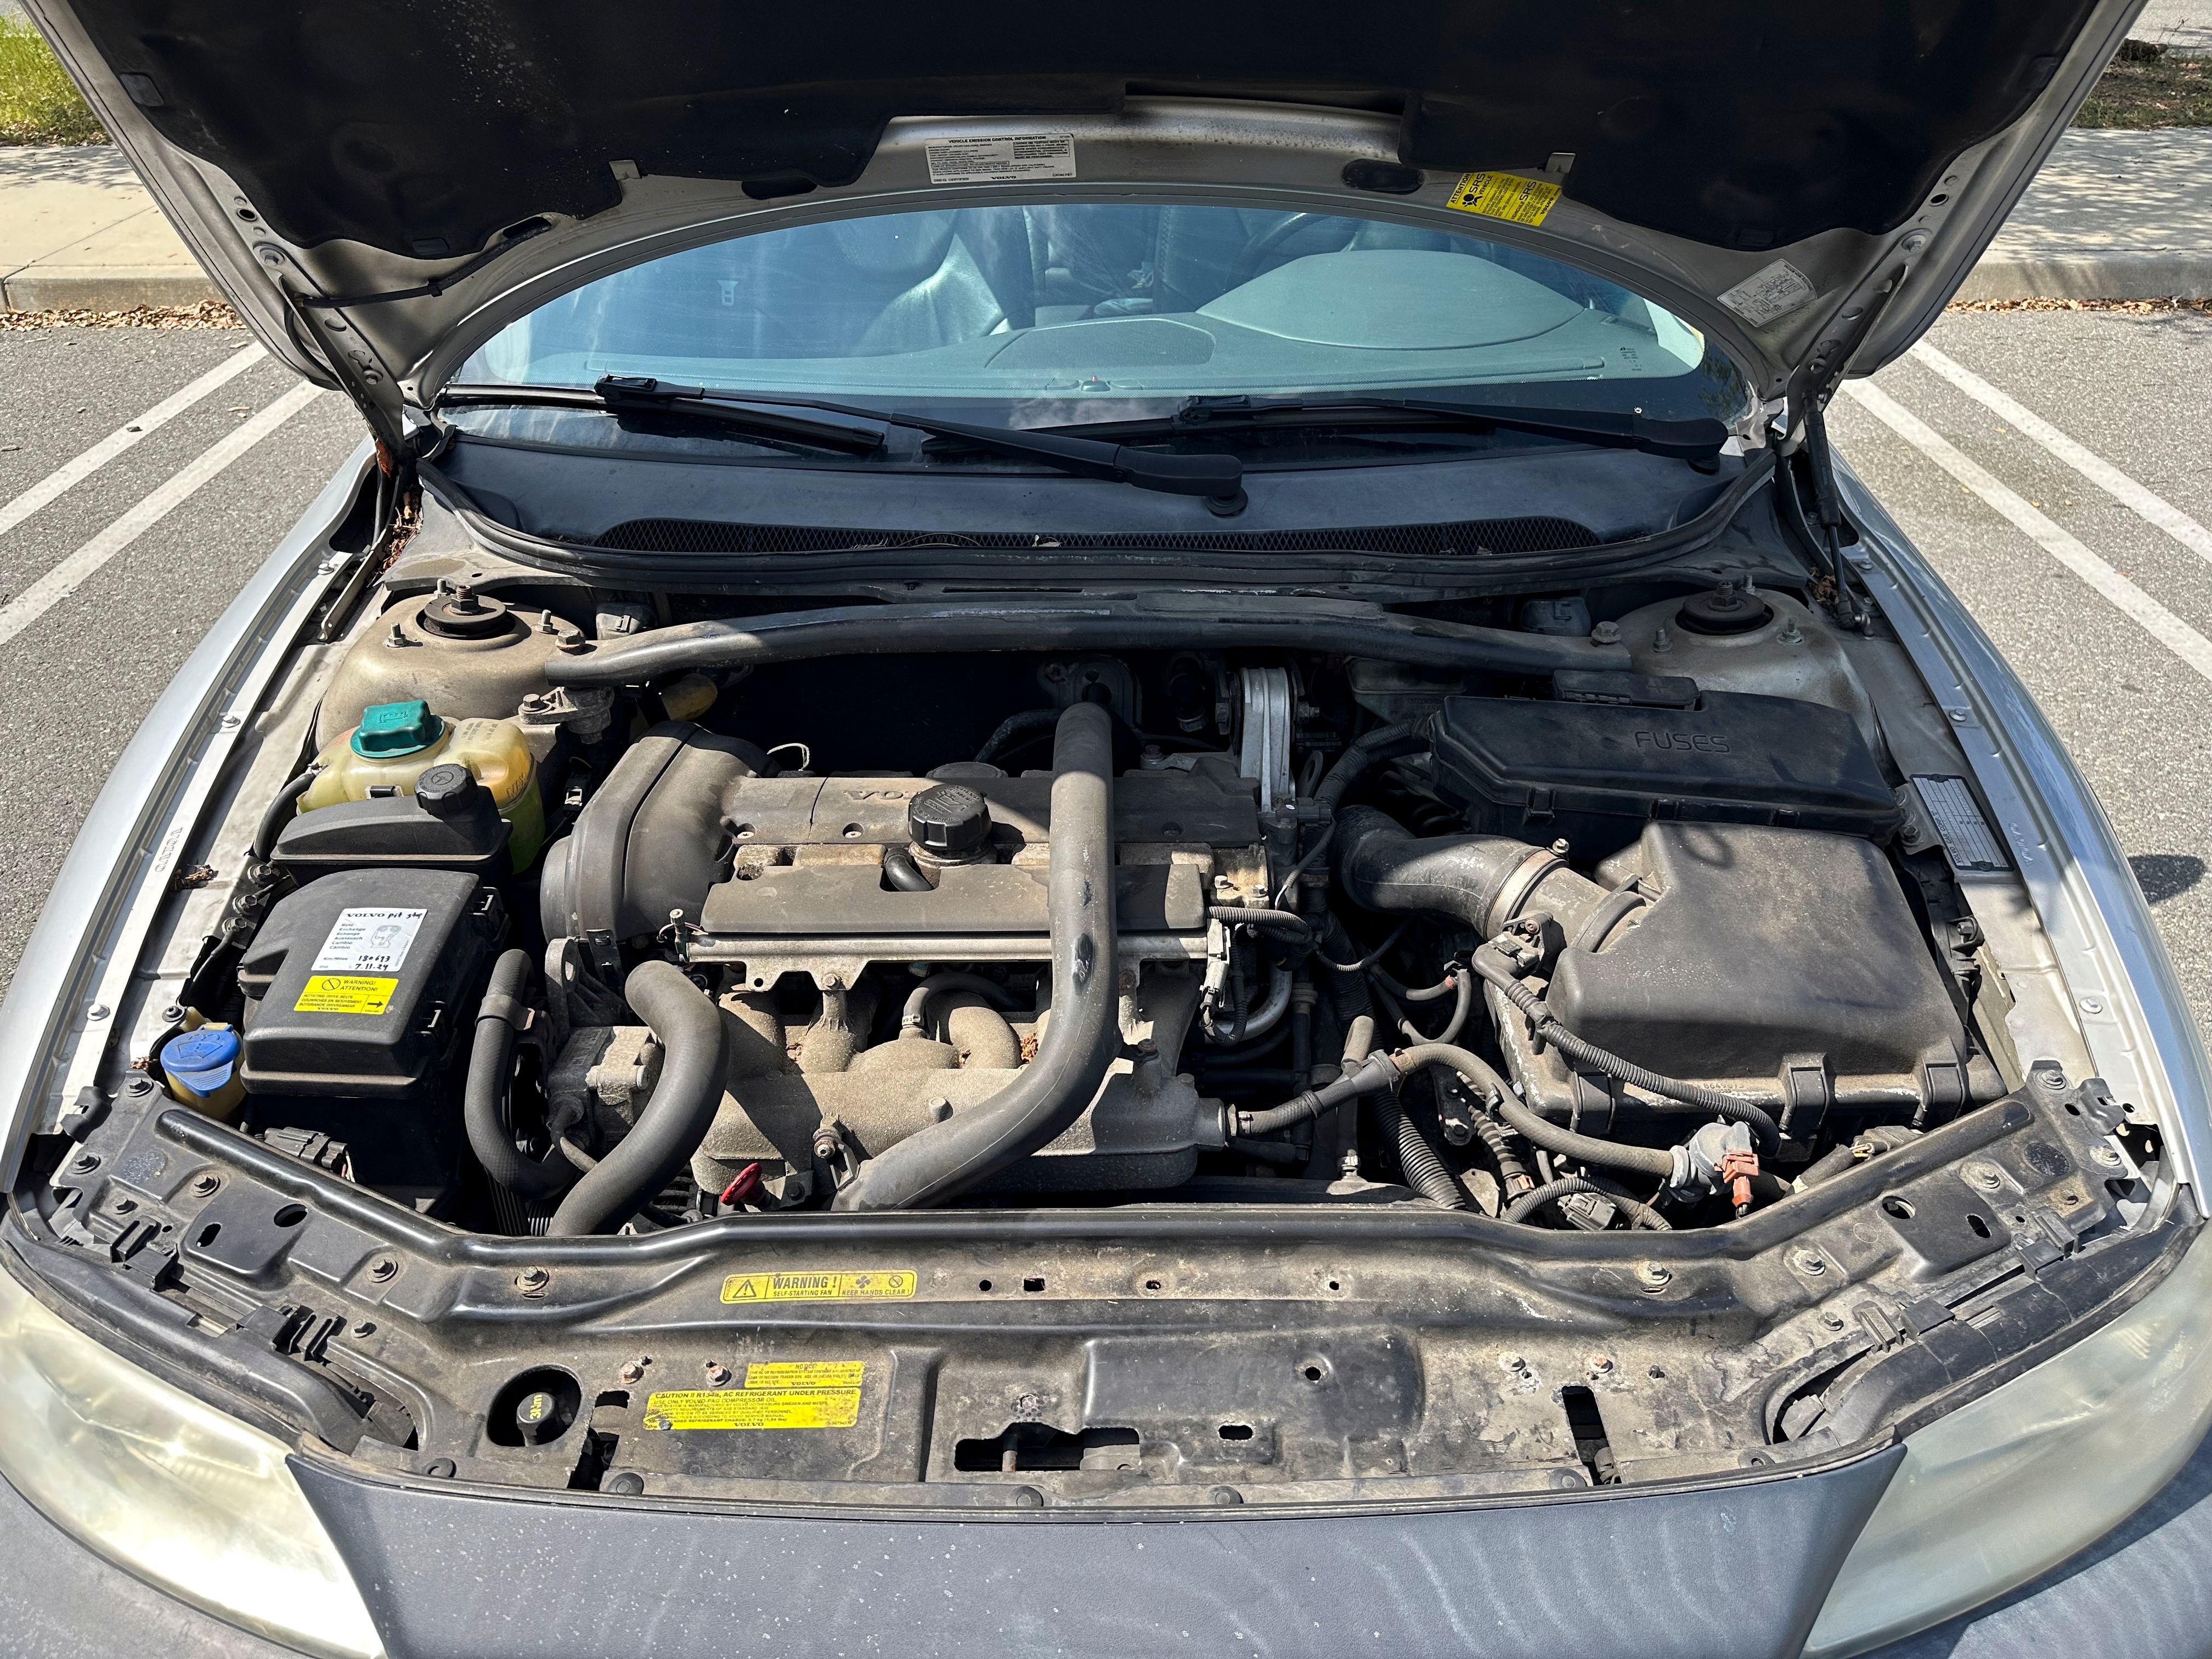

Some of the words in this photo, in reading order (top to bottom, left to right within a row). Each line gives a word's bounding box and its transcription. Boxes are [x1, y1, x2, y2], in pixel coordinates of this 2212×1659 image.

[1469, 173, 1486, 193] SRS
[1479, 175, 1493, 195] VEHICLE
[1519, 180, 1537, 201] SRS
[1541, 197, 1554, 215] VOLVO
[1634, 731, 1731, 753] FUSES
[506, 772, 528, 799] MAX
[1943, 833, 1952, 844] CAR
[155, 827, 183, 872] VOLVO
[1950, 847, 1961, 864] VOLVO
[773, 1276, 828, 1289] WARNING
[530, 1395, 543, 1419] 3Nm
